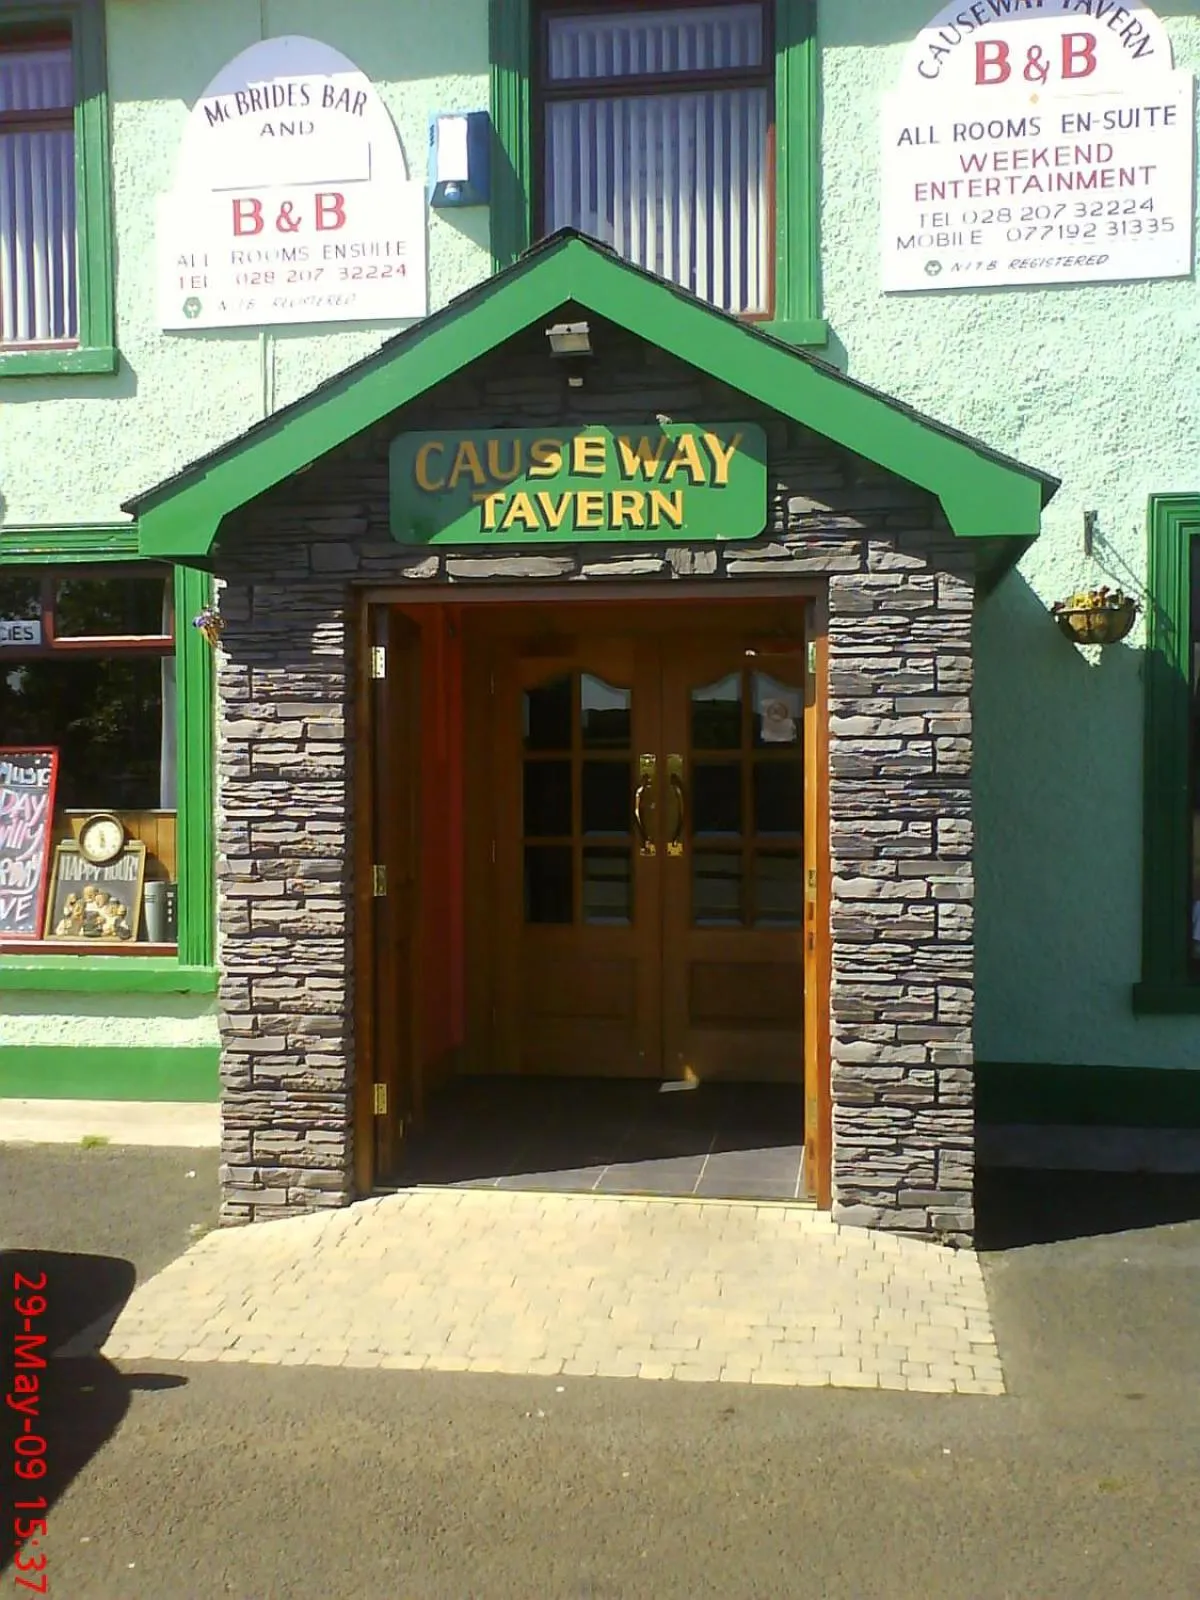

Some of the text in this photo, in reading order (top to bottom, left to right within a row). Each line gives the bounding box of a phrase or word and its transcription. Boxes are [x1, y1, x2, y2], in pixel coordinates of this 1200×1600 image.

[917, 0, 1043, 79] CAUSEW
[322, 84, 367, 117] BAR
[260, 121, 314, 137] AND
[896, 104, 1177, 146] ALL ROOMS EN-SUITE
[960, 143, 1114, 173] WEEKEND
[914, 165, 1157, 202] ENTERTAINMENT
[920, 197, 1154, 228] TEL 028 207 32224
[896, 216, 1175, 251] MOBILE 077192 31335
[231, 246, 309, 265] ROOMS
[1008, 254, 1109, 271] REGISTERED
[235, 271, 275, 285] 028
[286, 268, 324, 283] 207
[338, 264, 407, 281] 32224
[414, 432, 742, 490] CAUSEWAY
[473, 488, 683, 531] TAVERN
